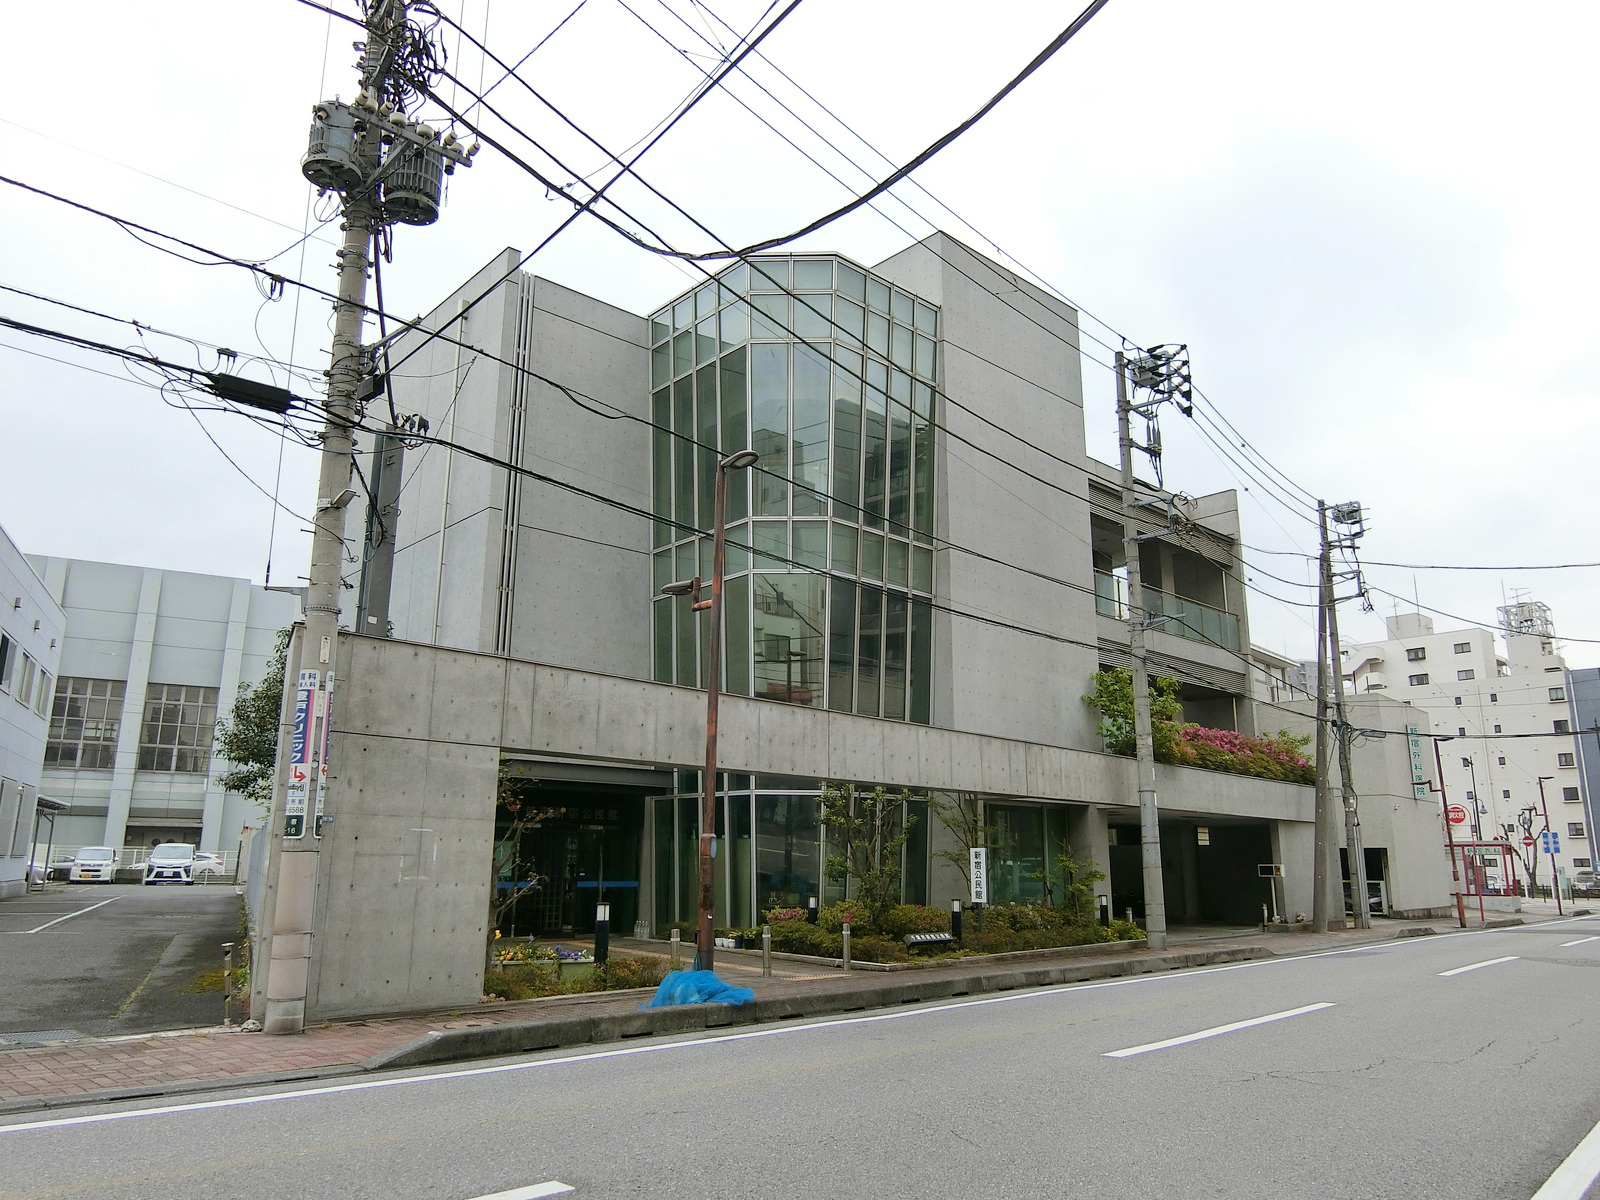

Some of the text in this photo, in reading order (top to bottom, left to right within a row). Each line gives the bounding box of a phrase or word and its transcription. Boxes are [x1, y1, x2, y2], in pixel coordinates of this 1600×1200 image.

[1409, 727, 1426, 796] 新宿外科医院
[974, 850, 983, 900] 新宿公民館
